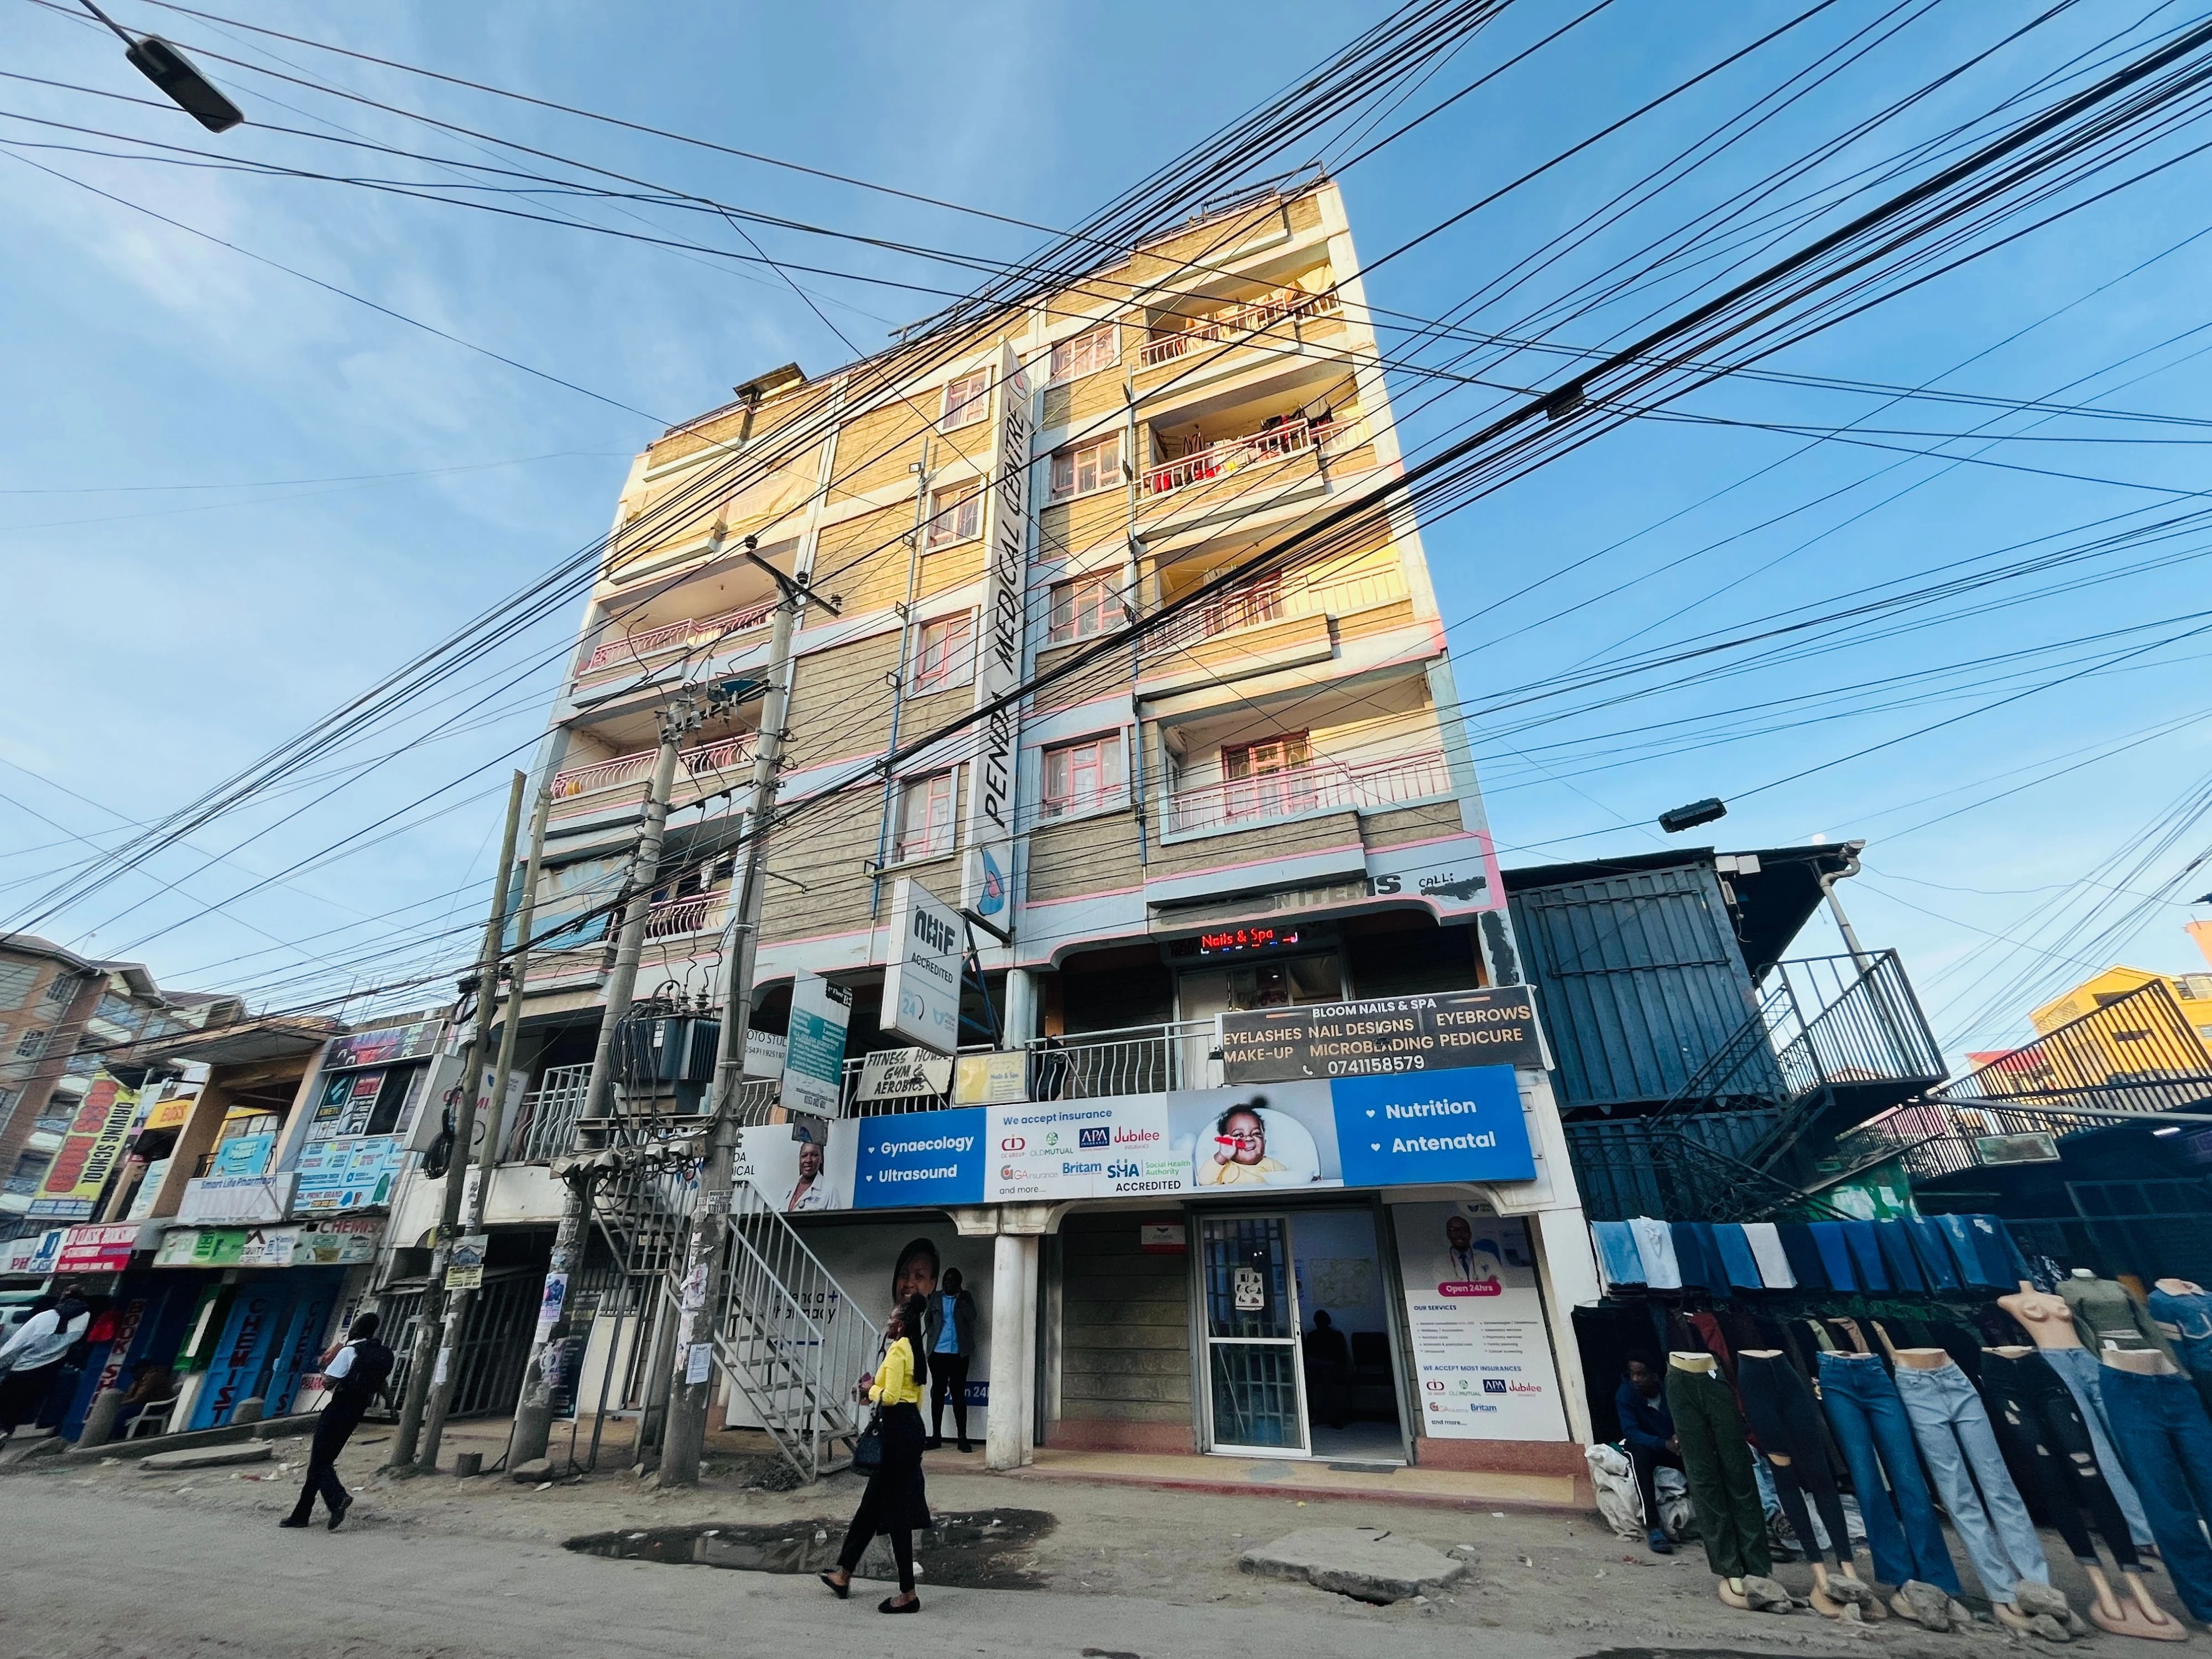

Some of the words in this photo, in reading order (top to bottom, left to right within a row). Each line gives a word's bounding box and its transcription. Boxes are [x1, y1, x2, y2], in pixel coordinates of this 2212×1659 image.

[1001, 397, 1024, 517] CENTRE
[995, 520, 1019, 675] MEDICAL
[985, 691, 1010, 828] PENDA
[1418, 873, 1454, 888] CALL:
[1201, 932, 1234, 948] Nails
[1237, 929, 1247, 943] &
[1250, 927, 1274, 943] Spa
[911, 952, 953, 984] ACCREDITED
[902, 998, 915, 1018] 24
[1312, 1005, 1357, 1018] BLOOM
[1359, 1001, 1395, 1014] NAILS
[1397, 1000, 1408, 1011] &
[1410, 998, 1437, 1010] SPA
[1223, 1027, 1302, 1046] EYELASHES
[1308, 1023, 1343, 1039] NAIL
[1345, 1018, 1414, 1036] DESIGNS
[1436, 1005, 1531, 1026] EYEBROWS
[1224, 1046, 1294, 1063] MAKE-UP
[1439, 1027, 1524, 1047] PEDICURE
[867, 1051, 909, 1067] FITNESS
[914, 1048, 948, 1062] HOU
[1328, 1055, 1425, 1074] 0741158579
[884, 1064, 911, 1080] GYM
[874, 1081, 925, 1095] AEROBICS
[1003, 1117, 1019, 1125] We
[1021, 1113, 1057, 1125] accept
[1059, 1110, 1112, 1121] insurance
[1385, 1098, 1477, 1119] Nutrition
[101, 1102, 135, 1142] DRIVING
[1082, 1129, 1108, 1142] APA
[1114, 1125, 1160, 1143] Jubilee
[1391, 1130, 1496, 1153] Antenatal
[880, 1135, 974, 1158] Gynaecology
[81, 1145, 116, 1184] SCHOOL
[732, 1165, 755, 1176] ICAL
[878, 1164, 958, 1183] Ultrasound
[1062, 1162, 1102, 1174] Britam
[1107, 1159, 1139, 1178] SHA
[1146, 1168, 1179, 1176] Authority
[201, 1180, 223, 1189] Smart
[223, 1178, 237, 1188] Life
[999, 1186, 1015, 1194] and
[1116, 1180, 1181, 1192] ACCREDITED
[1446, 1285, 1468, 1294] Open
[1469, 1284, 1494, 1292] 24hrs
[212, 1297, 269, 1425] CHEMIST
[1485, 1380, 1505, 1390] APA
[1509, 1379, 1542, 1392] Jubilee
[1470, 1403, 1497, 1412] Britam
